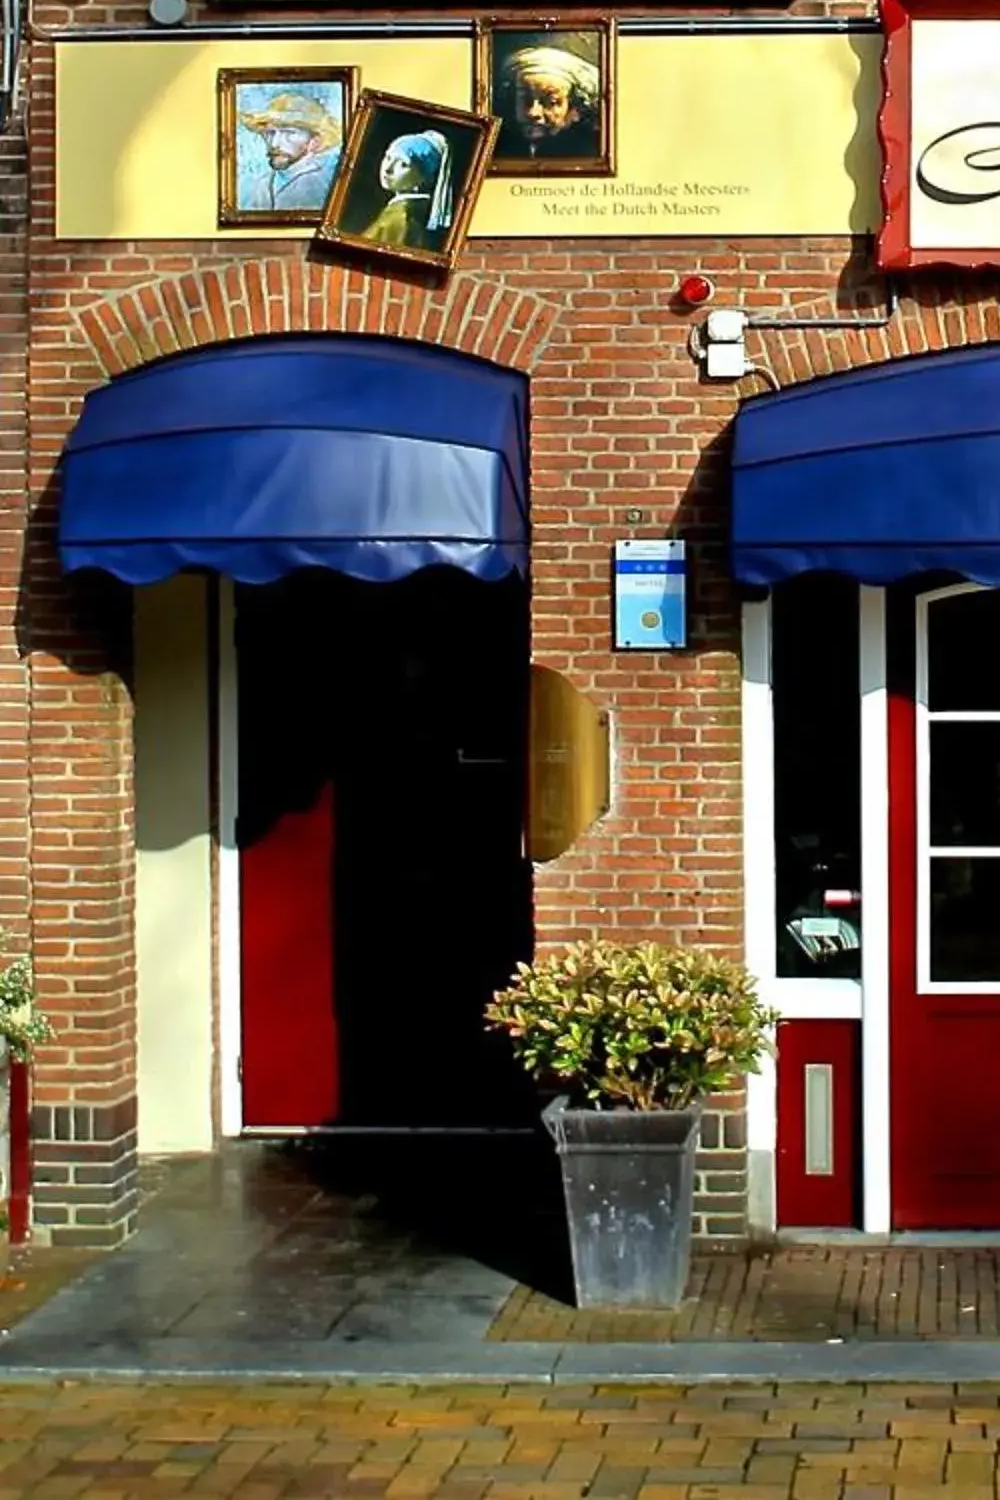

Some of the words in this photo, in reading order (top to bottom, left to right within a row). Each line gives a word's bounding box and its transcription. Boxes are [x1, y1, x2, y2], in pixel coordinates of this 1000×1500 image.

[509, 183, 575, 197] Ontmoet
[579, 183, 599, 197] de
[603, 183, 679, 197] Hollandse
[683, 183, 750, 196] Meesters
[542, 202, 580, 216] Meet
[584, 202, 607, 216] the
[612, 202, 658, 216] Dutch
[663, 202, 721, 216] Masters
